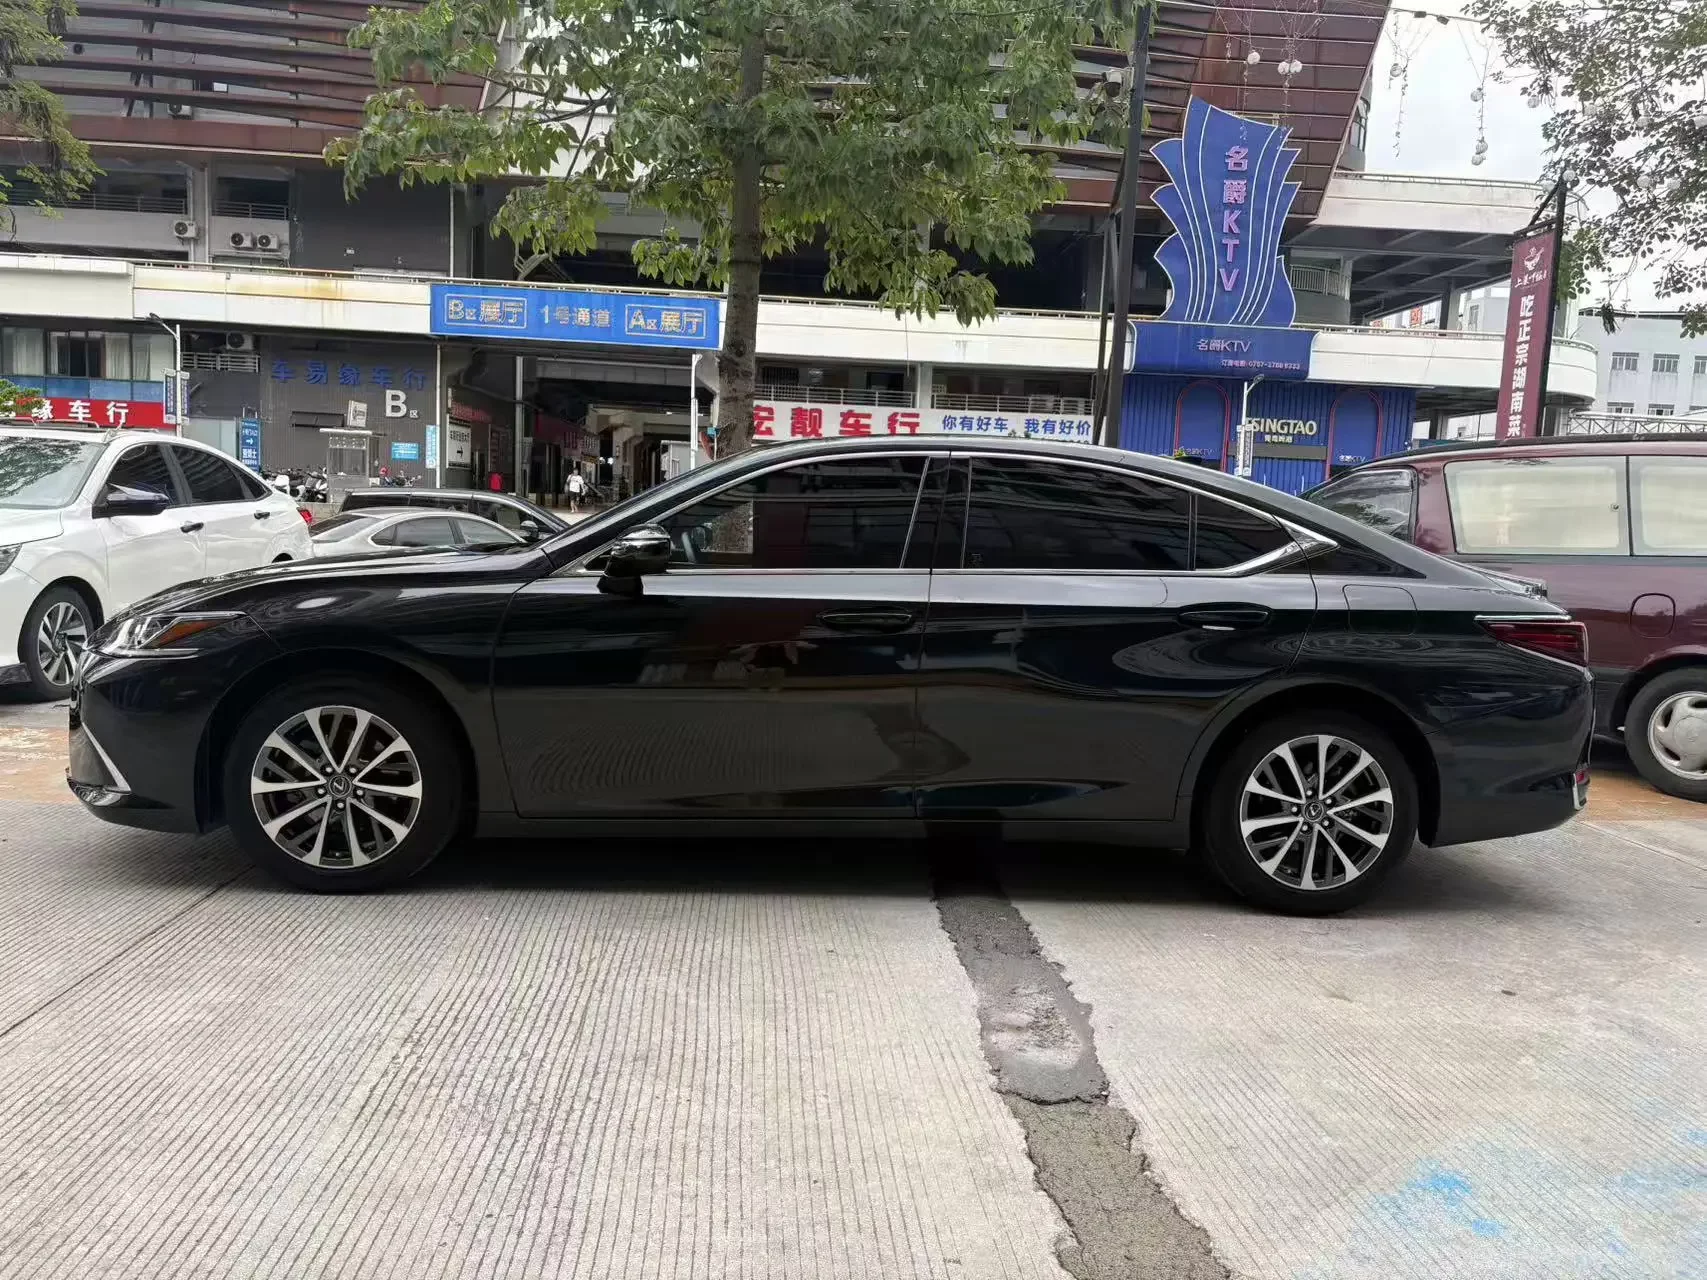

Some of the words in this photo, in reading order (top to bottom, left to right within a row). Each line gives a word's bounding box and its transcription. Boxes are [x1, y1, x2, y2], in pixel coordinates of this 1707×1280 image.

[1219, 145, 1249, 292] 名爵KTV
[448, 299, 523, 325] B区展厅
[540, 304, 612, 328] 1号通道
[628, 309, 703, 334] A区展厅
[1197, 338, 1252, 353] 名爵KTV
[271, 360, 427, 391] 车易缘车行
[1507, 294, 1535, 437] 吃正宗湖南菜
[0, 399, 129, 424] 缘车行
[942, 415, 1009, 432] 你有好车
[1024, 418, 1092, 436] 我有好价
